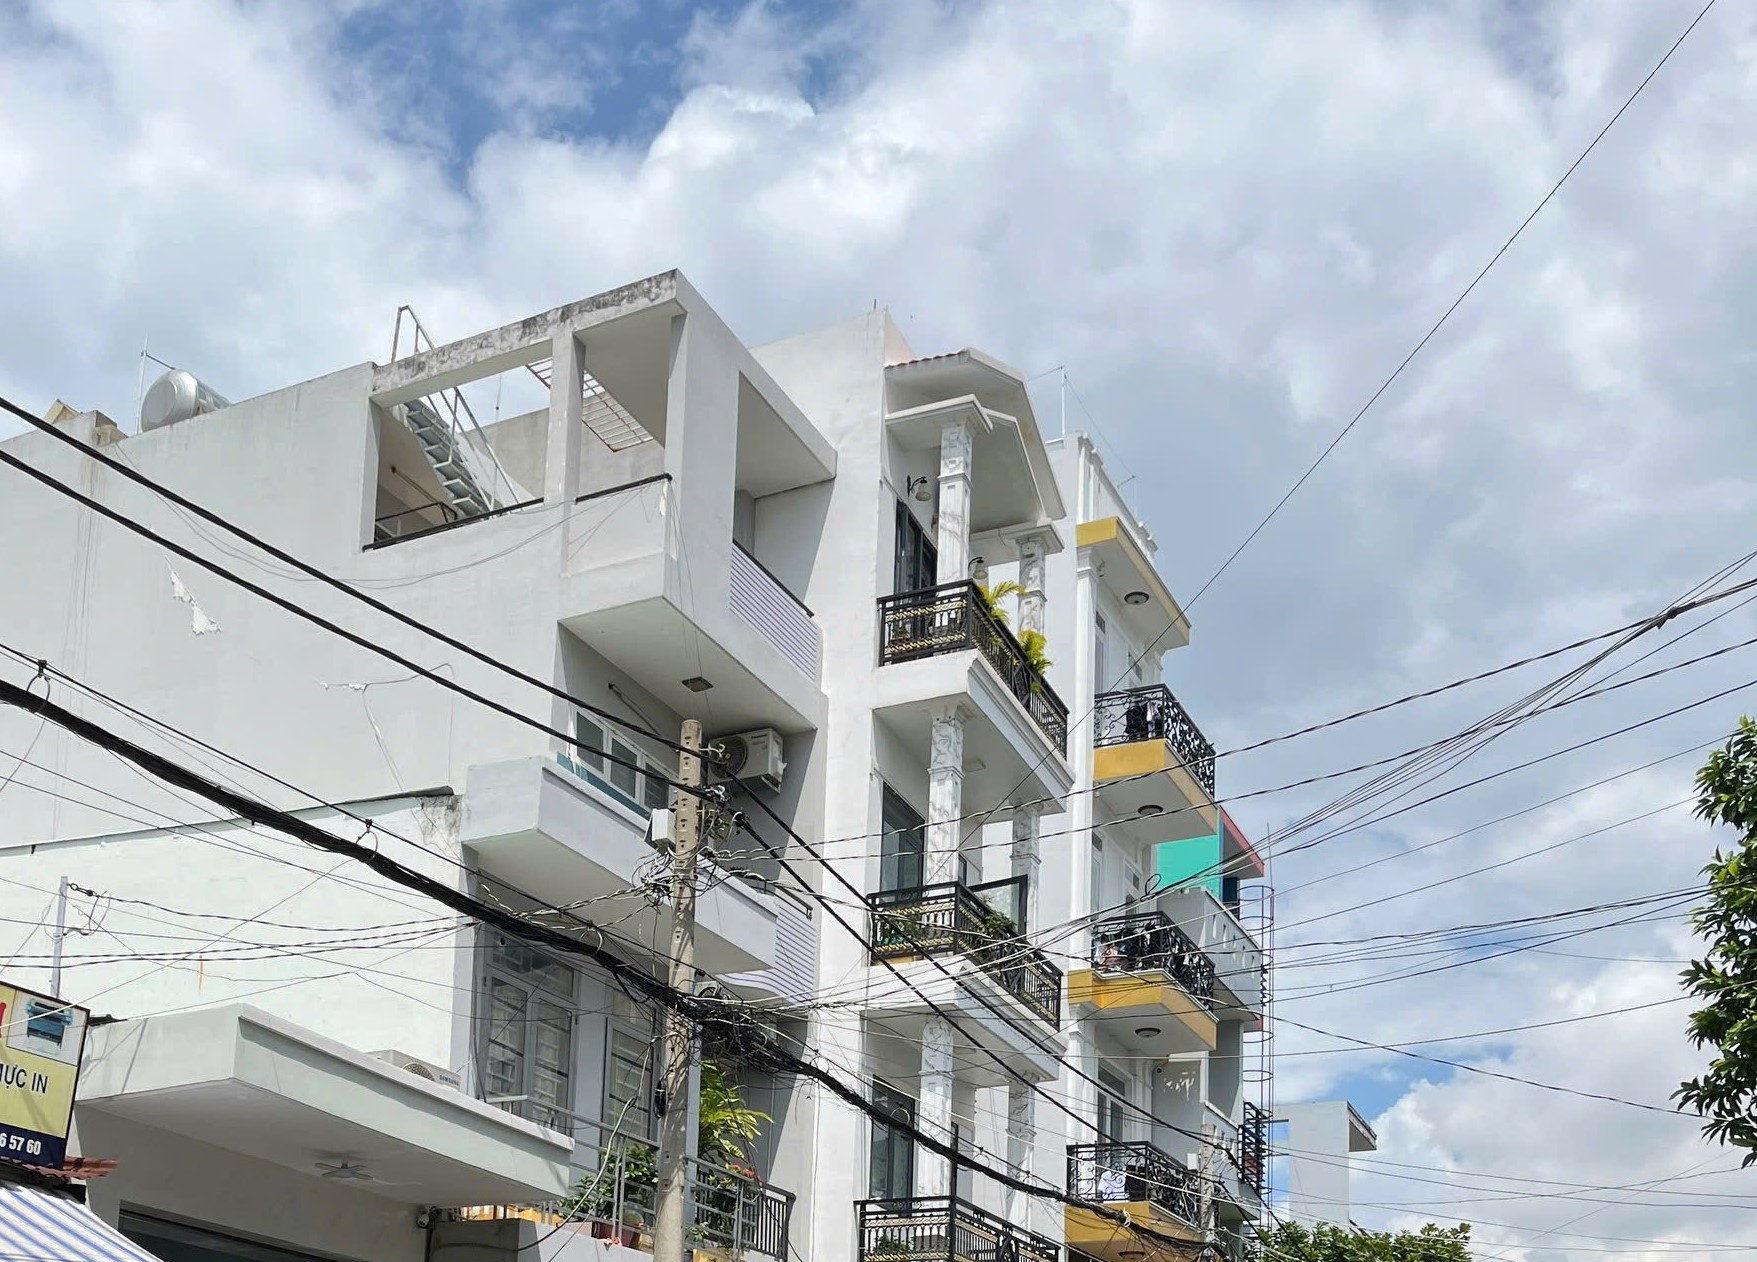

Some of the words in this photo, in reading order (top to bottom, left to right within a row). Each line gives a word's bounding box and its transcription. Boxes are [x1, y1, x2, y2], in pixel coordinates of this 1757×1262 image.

[0, 1063, 27, 1089] ỰC
[31, 1072, 48, 1094] IN
[8, 1134, 24, 1152] 57
[26, 1139, 42, 1156] 60
